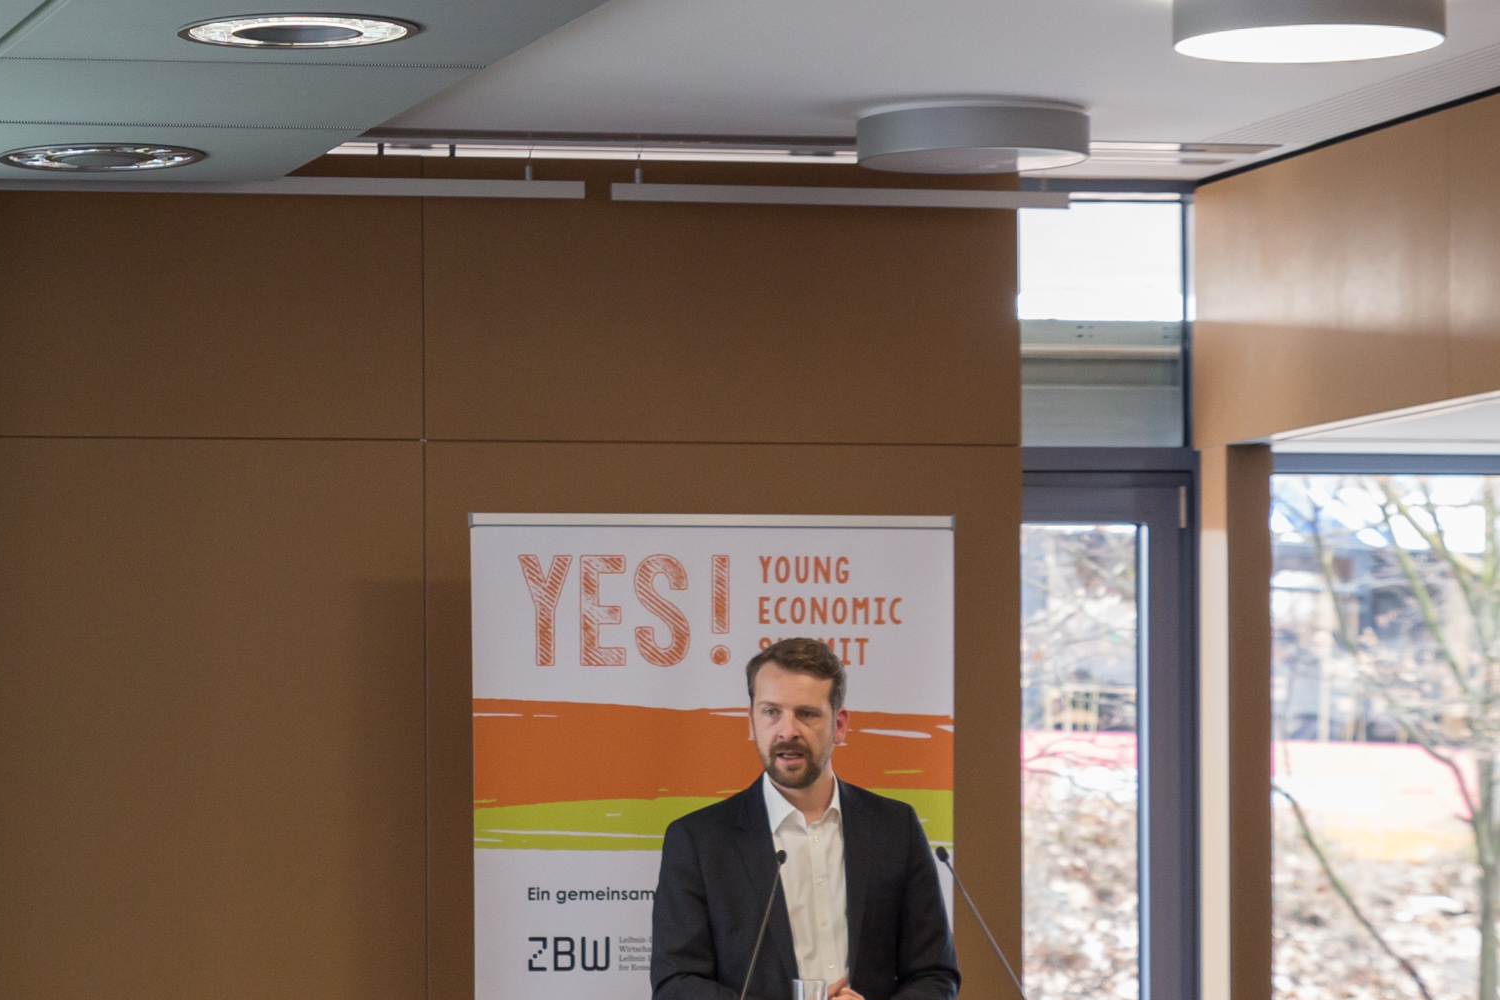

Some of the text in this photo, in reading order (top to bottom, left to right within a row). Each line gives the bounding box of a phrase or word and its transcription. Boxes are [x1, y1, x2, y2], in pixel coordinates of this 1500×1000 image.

[758, 556, 850, 584] YOUNG
[517, 553, 731, 667] YES!
[758, 597, 903, 625] ECONOMIC
[528, 887, 550, 902] Ein
[528, 937, 610, 971] ZBW
